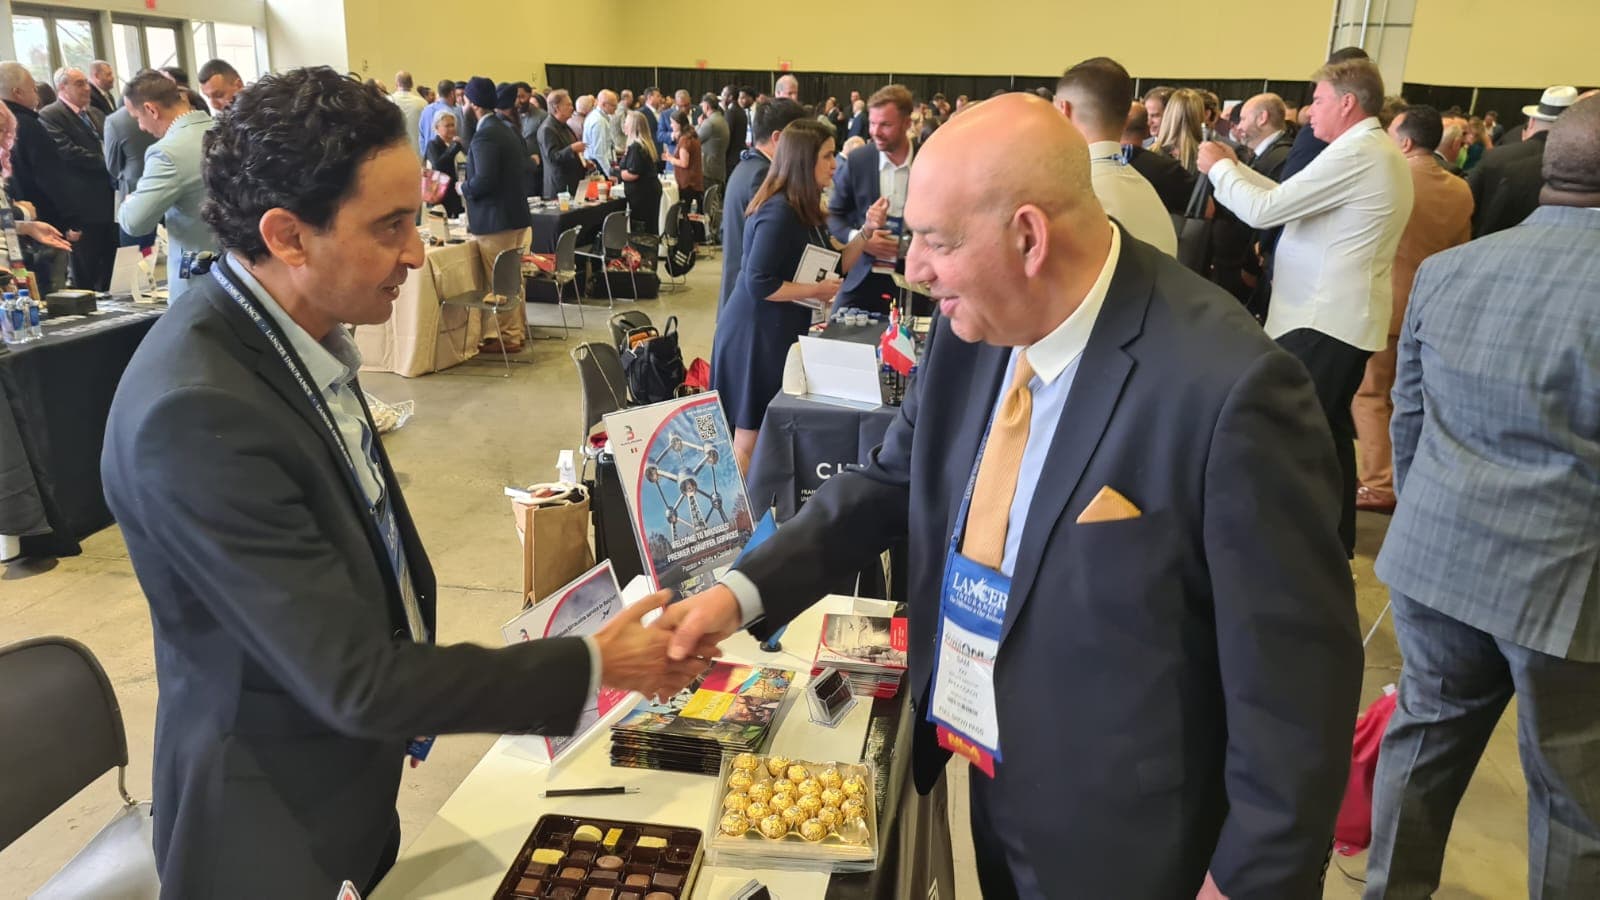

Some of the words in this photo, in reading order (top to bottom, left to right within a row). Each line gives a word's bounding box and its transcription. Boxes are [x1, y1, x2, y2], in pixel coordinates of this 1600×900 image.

[266, 329, 286, 357] LANCER
[284, 356, 313, 396] INSURANCE
[667, 549, 690, 562] PREMIER
[716, 530, 738, 543] SERVICES
[671, 535, 697, 549] WELCOME
[697, 532, 704, 540] TO
[704, 523, 730, 537] BRUSSELS
[952, 572, 1008, 611] LANCER
[956, 591, 1000, 615] INSURANCE
